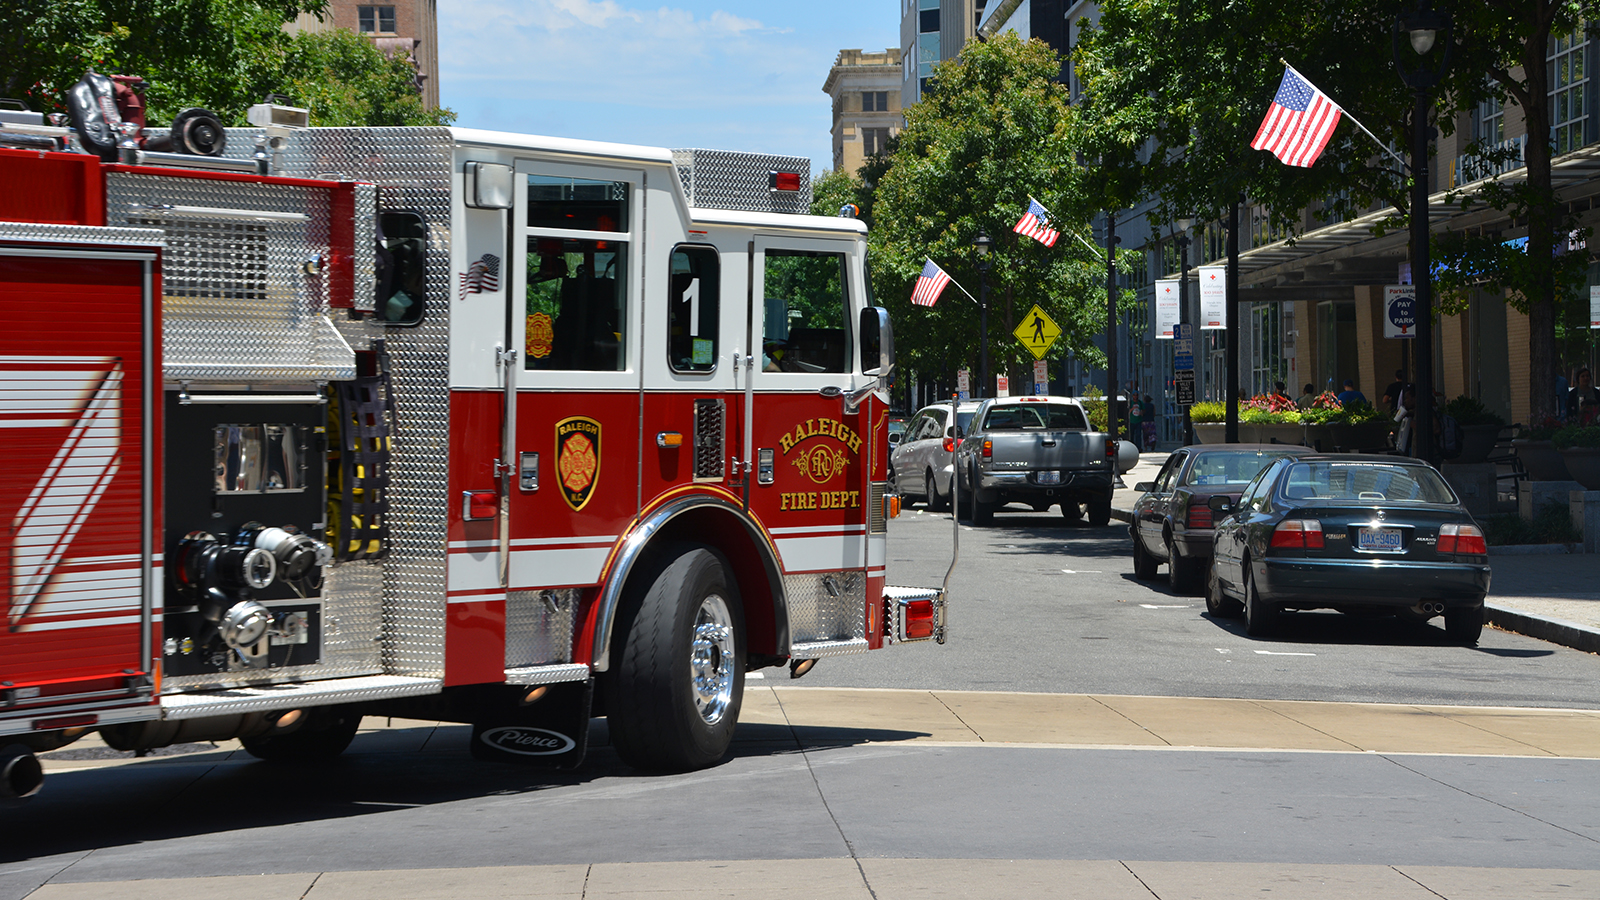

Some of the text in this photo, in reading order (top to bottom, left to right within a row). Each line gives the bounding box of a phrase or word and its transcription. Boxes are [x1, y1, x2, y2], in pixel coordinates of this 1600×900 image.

[682, 278, 700, 336] 1
[1175, 328, 1179, 338] 2
[559, 423, 597, 435] RALEIGH
[779, 418, 862, 456] RALEIGH
[571, 493, 584, 502] N.C.
[780, 491, 860, 511] FIRE DEPT.
[496, 730, 558, 748] Pierce
